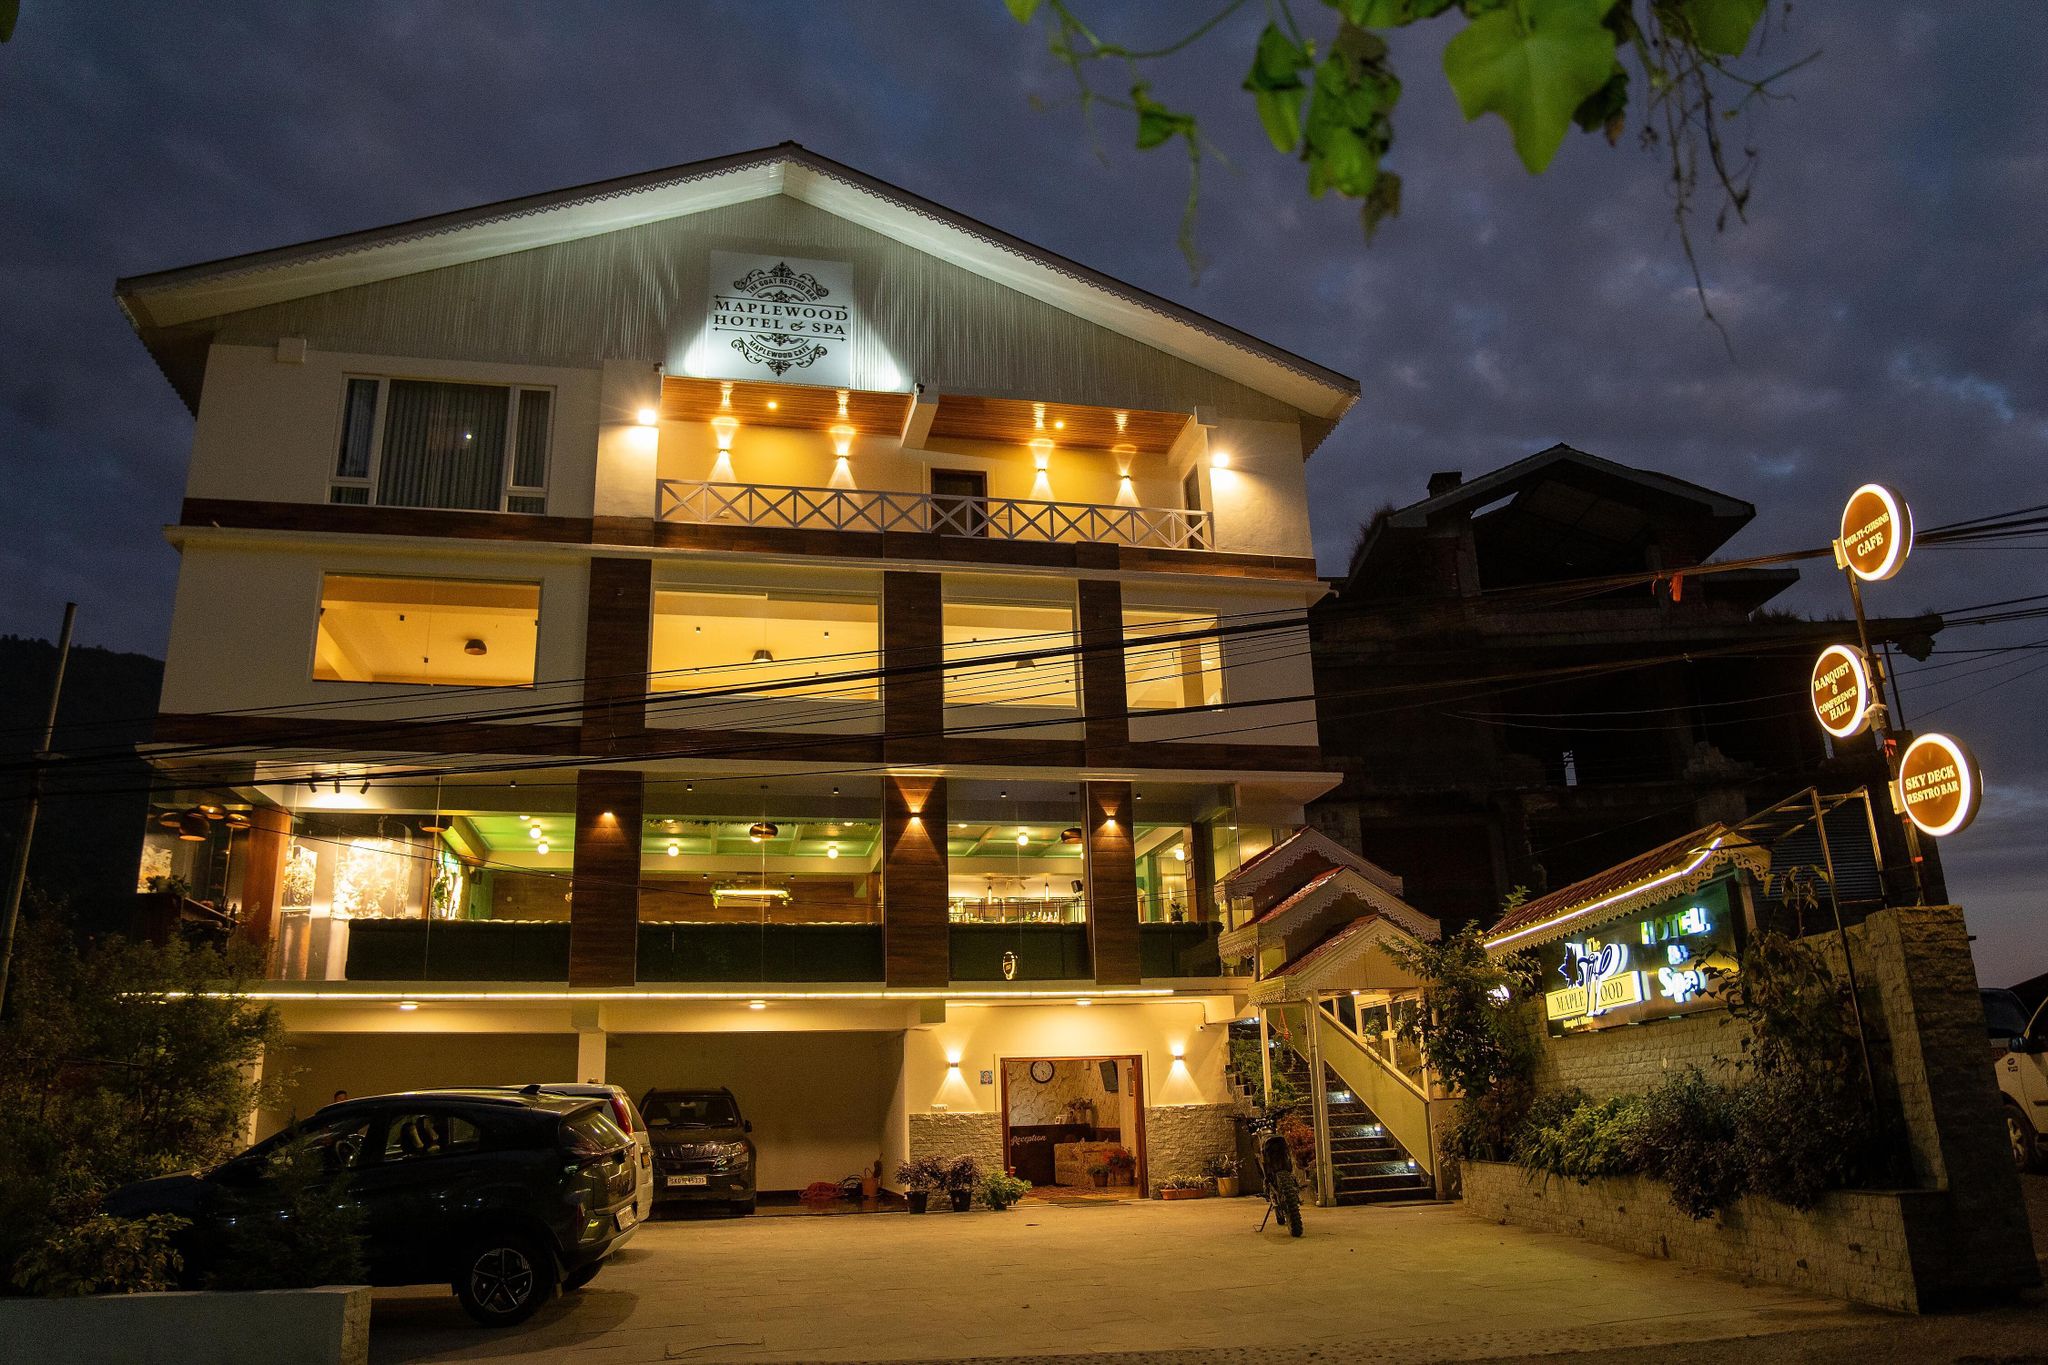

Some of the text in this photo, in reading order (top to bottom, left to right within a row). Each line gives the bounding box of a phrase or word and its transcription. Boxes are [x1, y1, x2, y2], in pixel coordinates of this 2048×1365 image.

[746, 277, 818, 301] THE GOAT RESTRO BAR
[714, 301, 848, 321] MAPLEWOOD
[713, 314, 847, 335] HOTEL & SPA
[748, 340, 811, 359] MAPLEWOOD CAFE
[1844, 512, 1890, 548] MULTI-CUISINE
[1857, 531, 1884, 557] CAFE
[1814, 661, 1850, 692] BANQUET
[1818, 686, 1857, 715] CONFERENCE
[1829, 701, 1851, 722] HALL
[1905, 764, 1956, 791] SKY DECK
[1906, 780, 1960, 805] RESTRO BAR
[1555, 990, 1587, 1012] MAPLE
